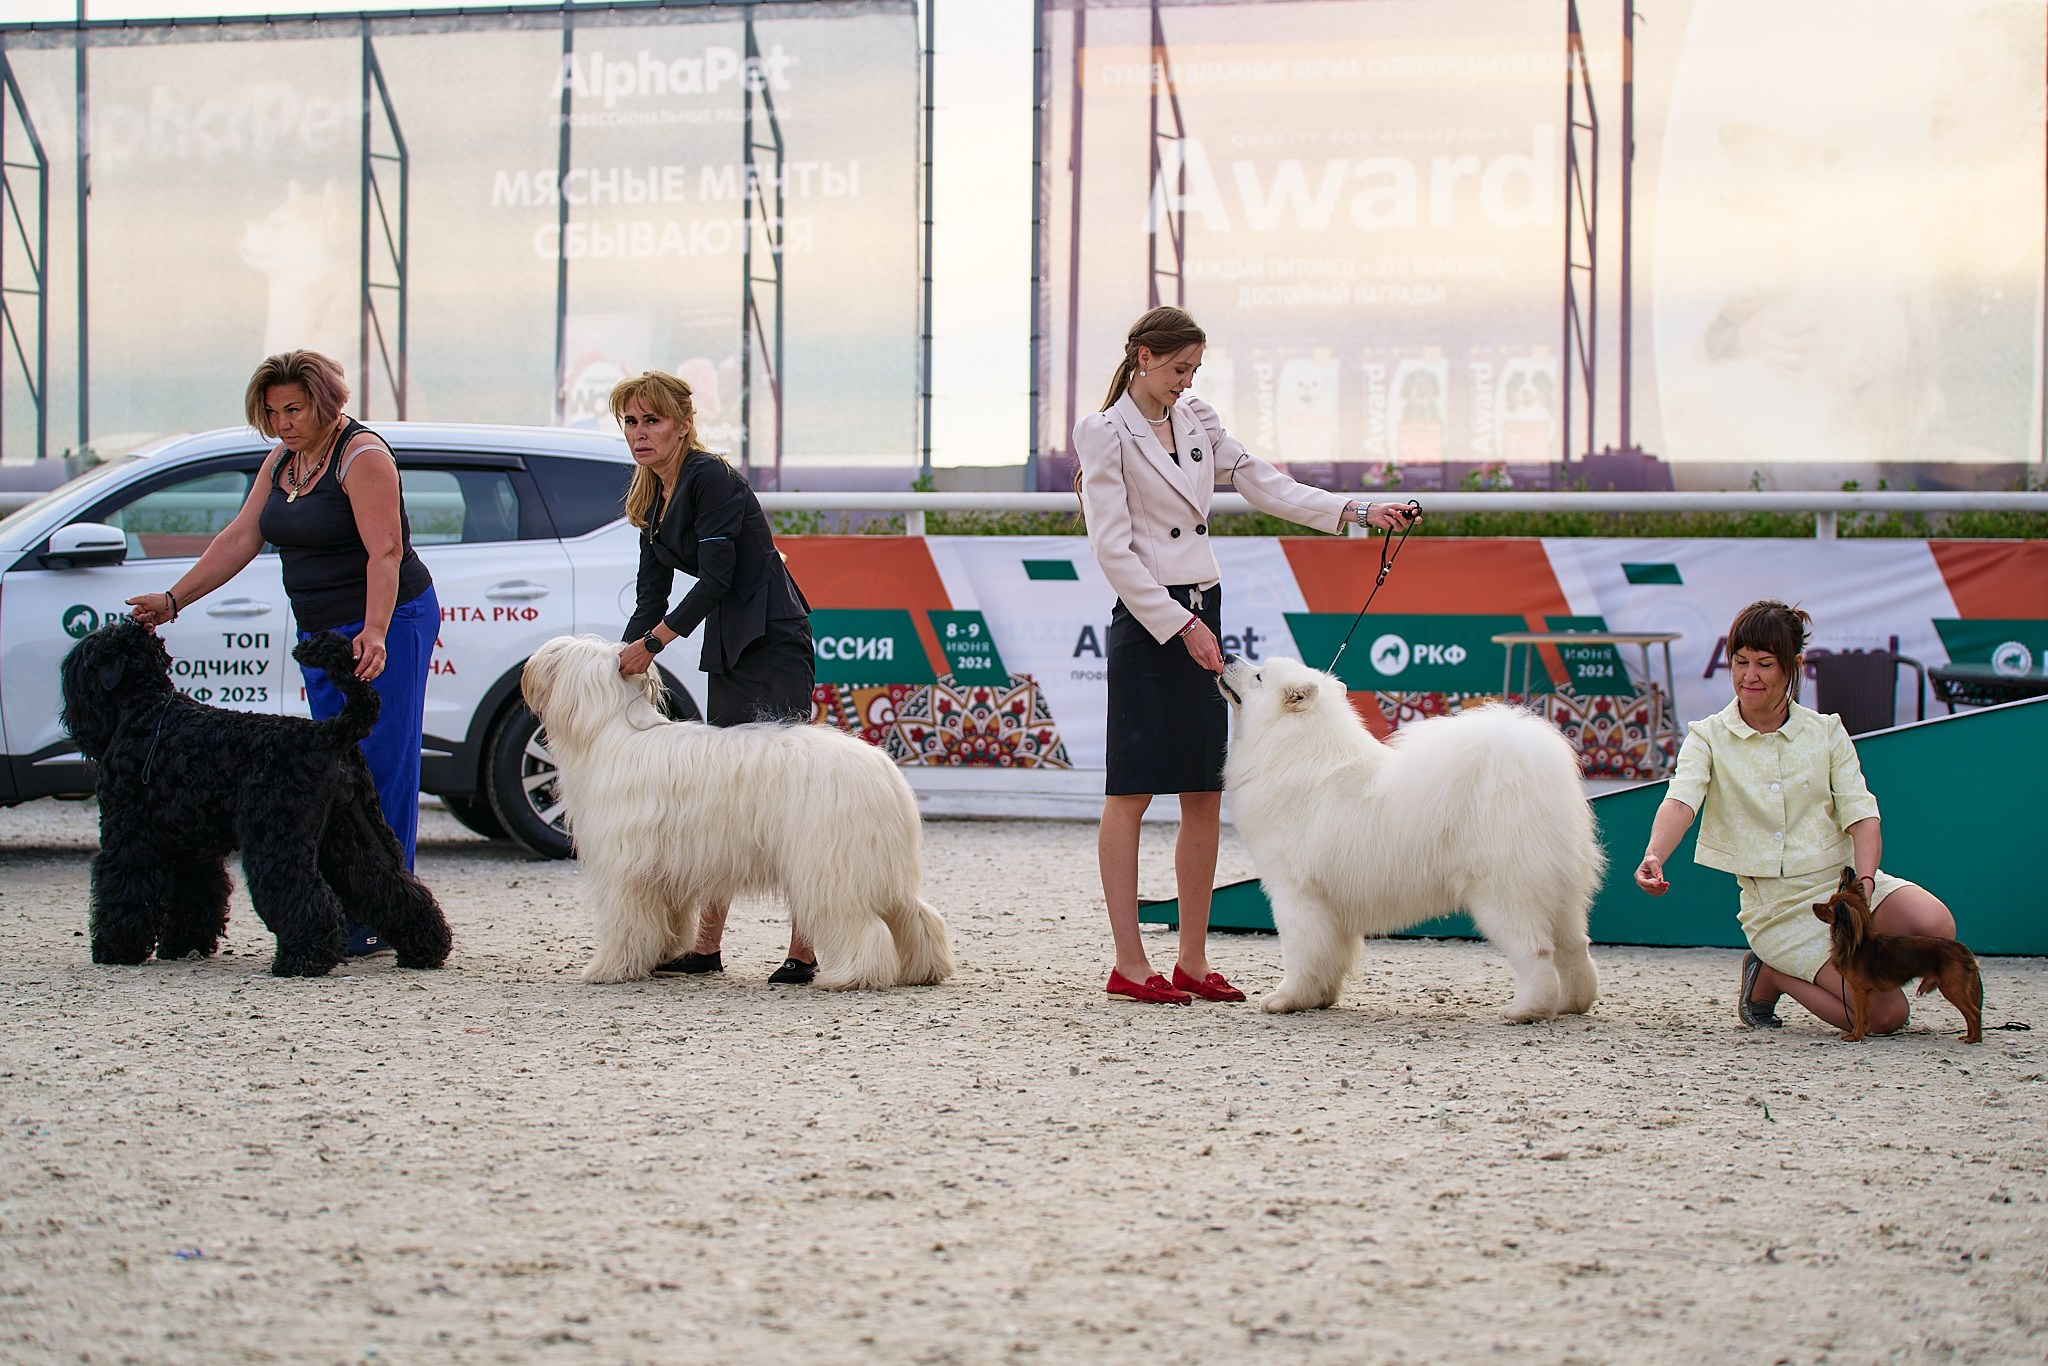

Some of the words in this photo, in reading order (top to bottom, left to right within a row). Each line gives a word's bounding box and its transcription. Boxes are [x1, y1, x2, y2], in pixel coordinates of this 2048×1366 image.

[551, 44, 792, 108] AlphaPet
[1231, 131, 1320, 147] QUALITY
[491, 165, 686, 208] МЯСНЫЕ
[699, 159, 860, 201] МЕЧТЫ
[1141, 123, 1556, 234] Award
[532, 215, 815, 259] СБЫВАЮТСЯ
[1255, 363, 1274, 451] Award
[1364, 363, 1386, 454] Award
[1469, 362, 1493, 455] Award
[441, 606, 486, 622] НТА
[493, 606, 539, 622] РКФ
[222, 632, 270, 649] ТОП
[812, 635, 895, 661] ССИЯ
[945, 641, 990, 653] ИЮНЯ
[957, 656, 992, 670] 2024
[1413, 643, 1468, 666] РКФ
[1577, 663, 1615, 679] 2024
[220, 686, 268, 703] 2023
